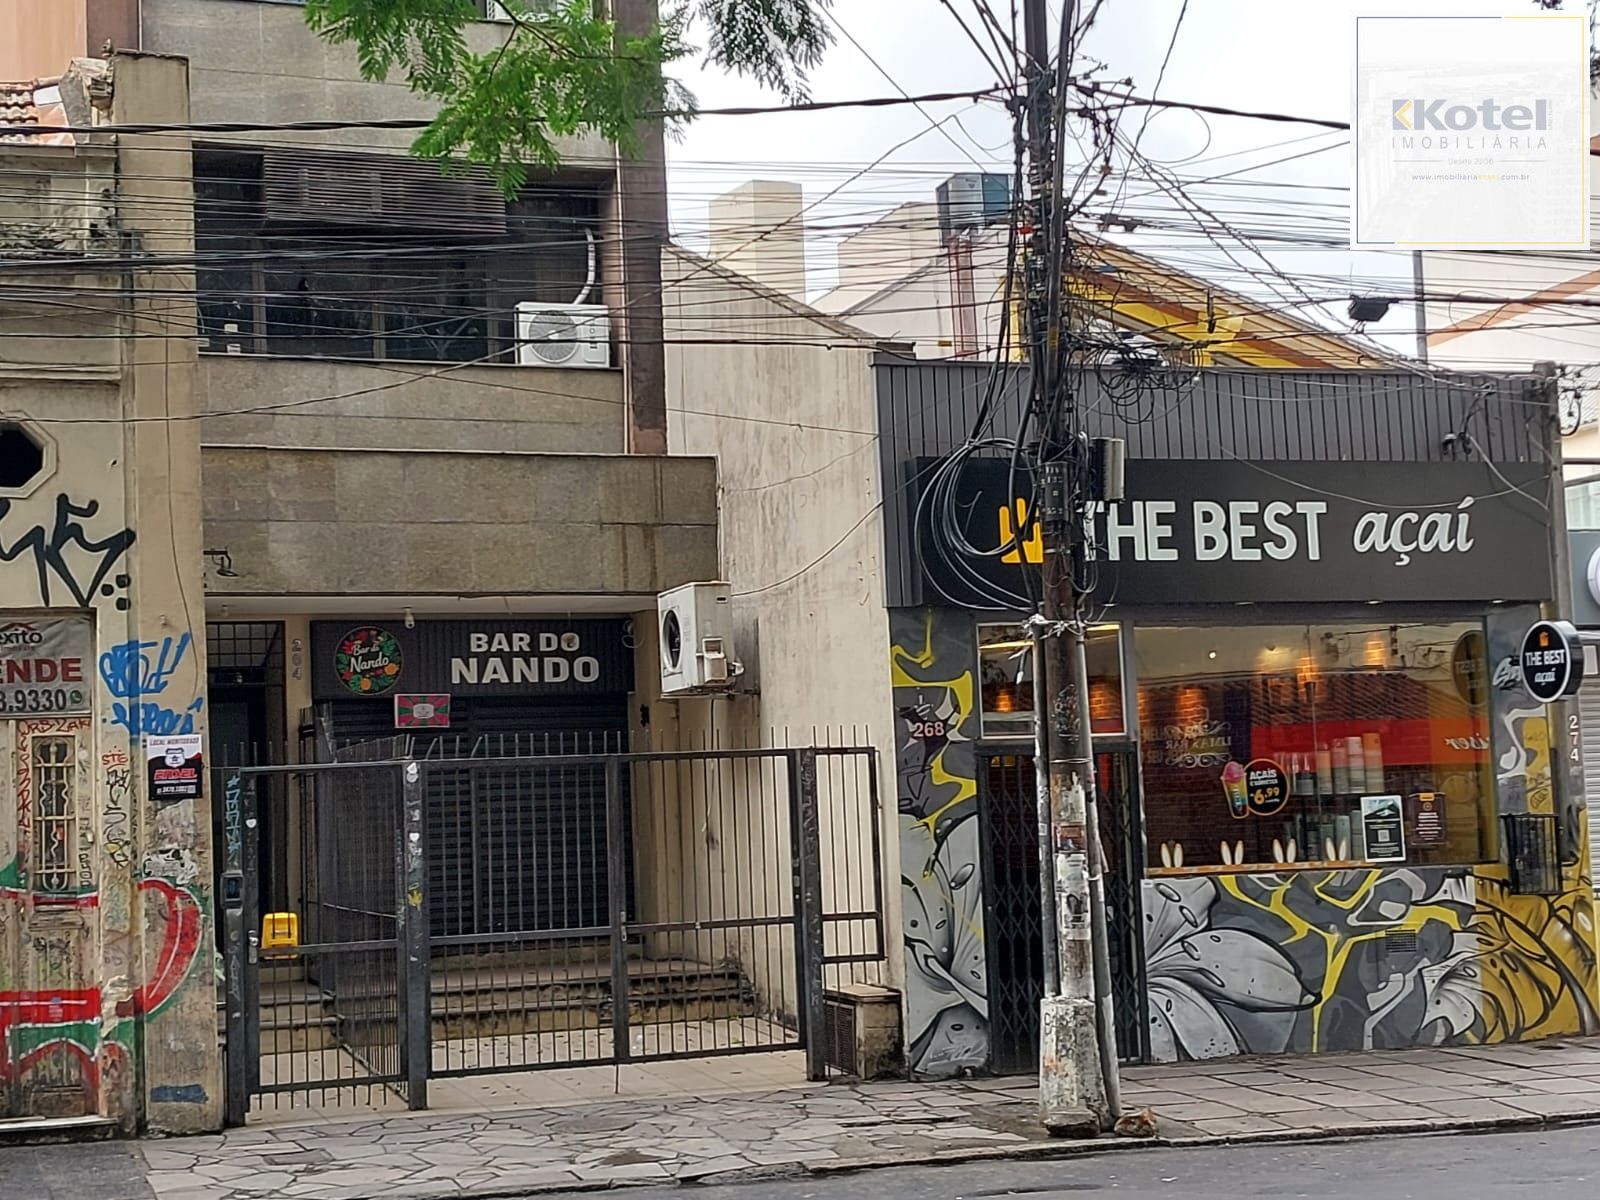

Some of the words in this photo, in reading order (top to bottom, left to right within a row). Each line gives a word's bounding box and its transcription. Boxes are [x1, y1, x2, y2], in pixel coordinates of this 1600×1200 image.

[1194, 501, 1327, 561] BEST
[1353, 496, 1475, 566] açaí
[352, 643, 369, 656] Bar
[470, 632, 531, 652] BAR
[539, 632, 580, 652] DO
[350, 652, 389, 672] Nando
[1525, 651, 1543, 667] THE
[1543, 649, 1565, 665] BEST
[0, 658, 82, 684] NDE
[451, 656, 599, 684] NANDO
[913, 721, 945, 737] 268
